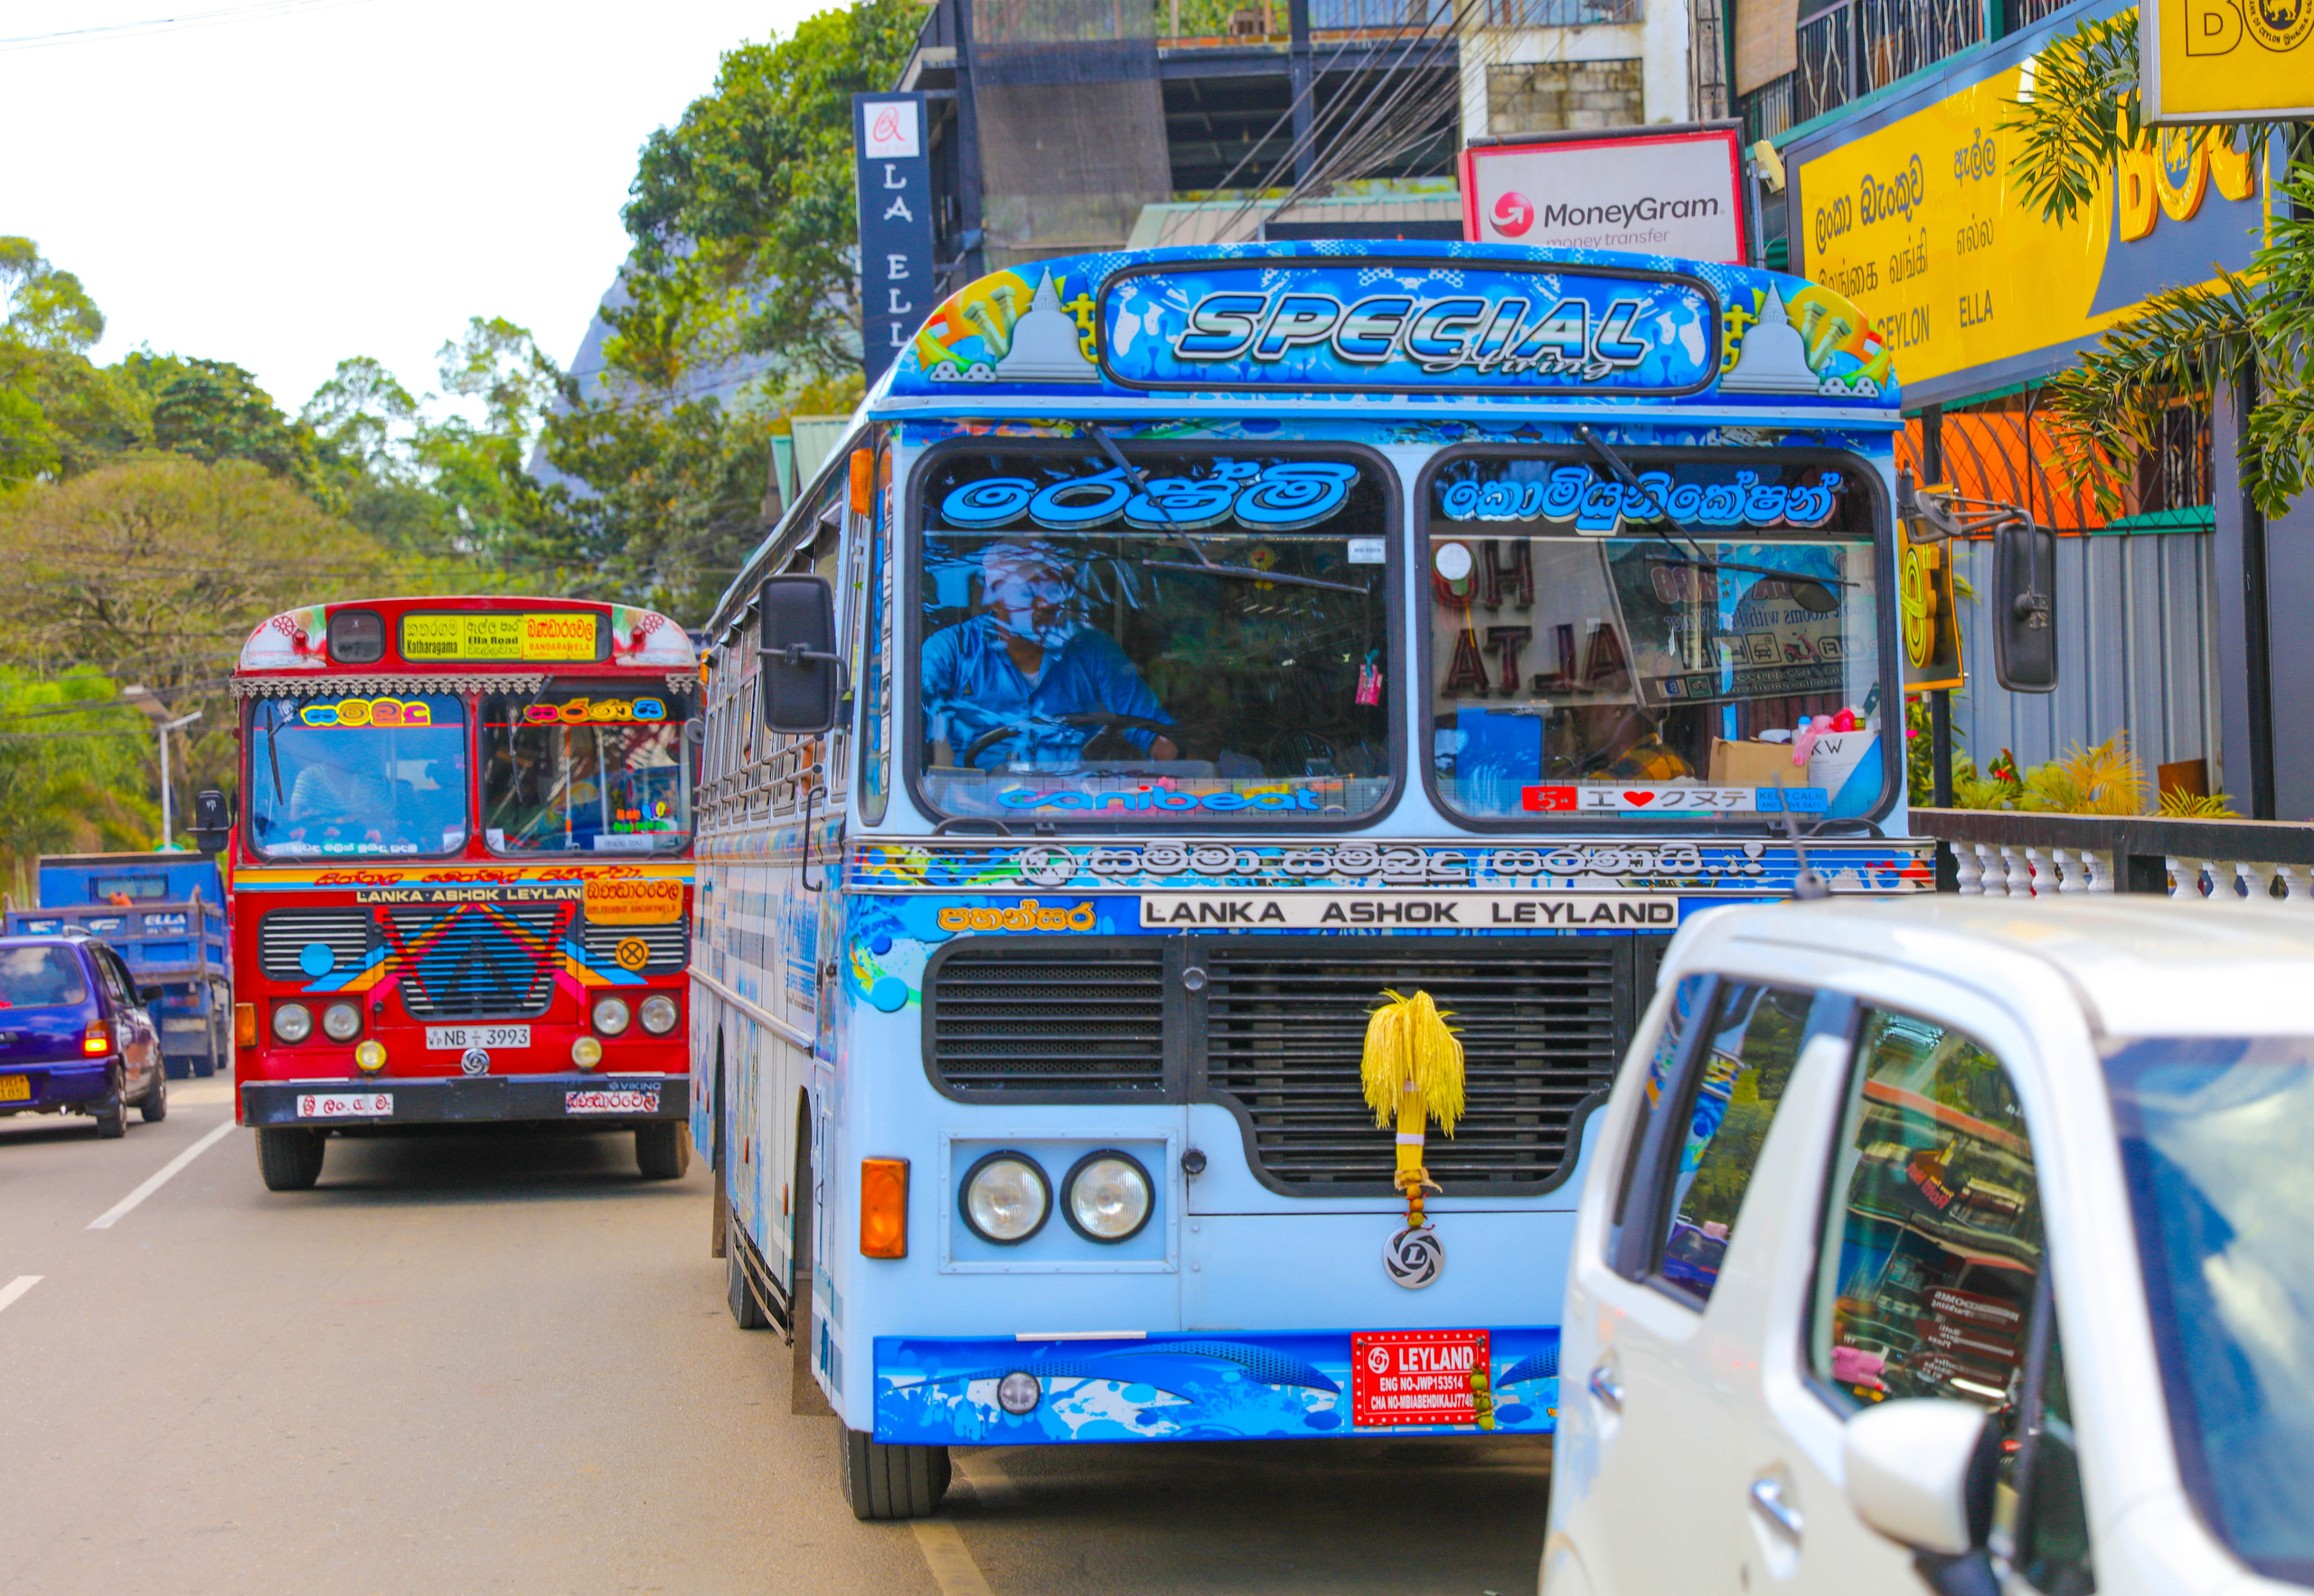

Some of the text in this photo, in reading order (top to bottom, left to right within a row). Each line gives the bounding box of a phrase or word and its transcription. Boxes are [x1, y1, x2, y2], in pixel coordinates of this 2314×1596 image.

[2259, 26, 2281, 43] CEYLON
[1544, 196, 1718, 229] MoneyGram
[1815, 193, 1852, 256] ලංකා
[1605, 228, 1670, 245] transfer
[1960, 289, 1994, 328] ELLA
[1176, 292, 1648, 363] SPECIAL
[407, 639, 458, 656] Katharagama
[468, 635, 519, 645] Ella Road
[529, 643, 591, 652] BANDARAWELA
[1792, 792, 1824, 801] CALM
[356, 887, 583, 903] LANKA ASHOK LEYLAN
[1145, 901, 1675, 924] LANKA ASHOK LEYLAND
[444, 1030, 466, 1047] NB
[485, 1028, 529, 1045] 3993
[619, 1082, 662, 1091] VIKING
[1398, 1346, 1474, 1372] LEYLAND
[1379, 1376, 1398, 1392] ENG
[1370, 1395, 1387, 1411] CHA
